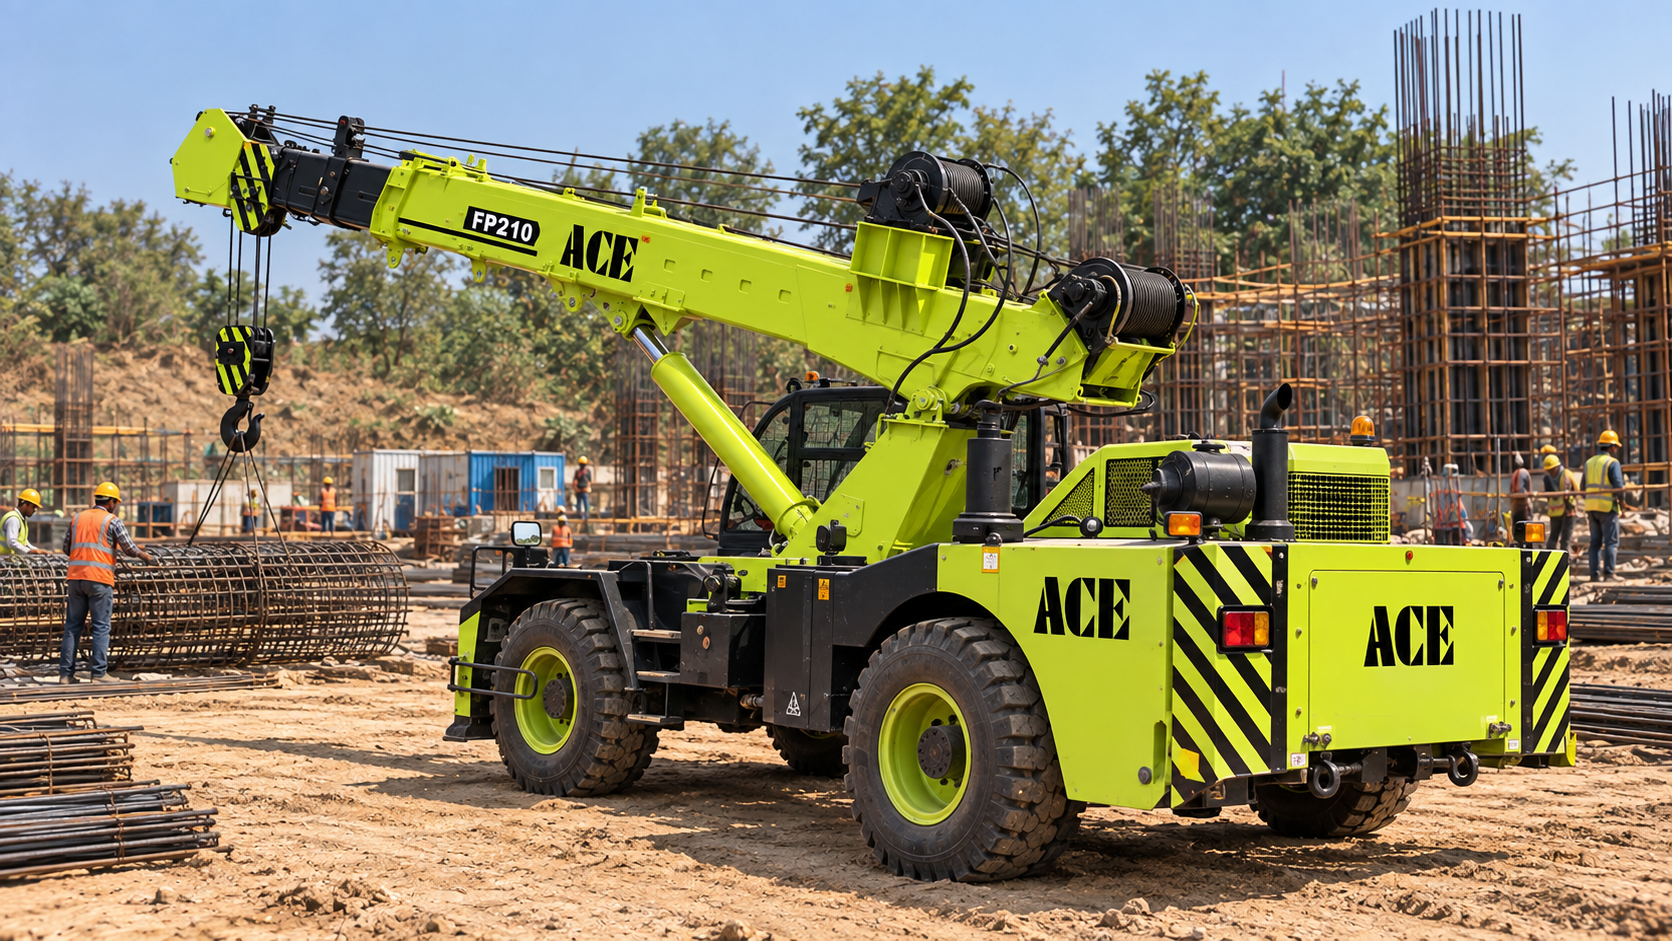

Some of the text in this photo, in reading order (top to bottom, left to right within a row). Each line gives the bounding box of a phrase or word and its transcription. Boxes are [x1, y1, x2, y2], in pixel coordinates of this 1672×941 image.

[471, 210, 533, 243] FP210
[560, 223, 639, 283] ACE
[1033, 576, 1131, 641] ACE
[1363, 605, 1454, 668] ACE
